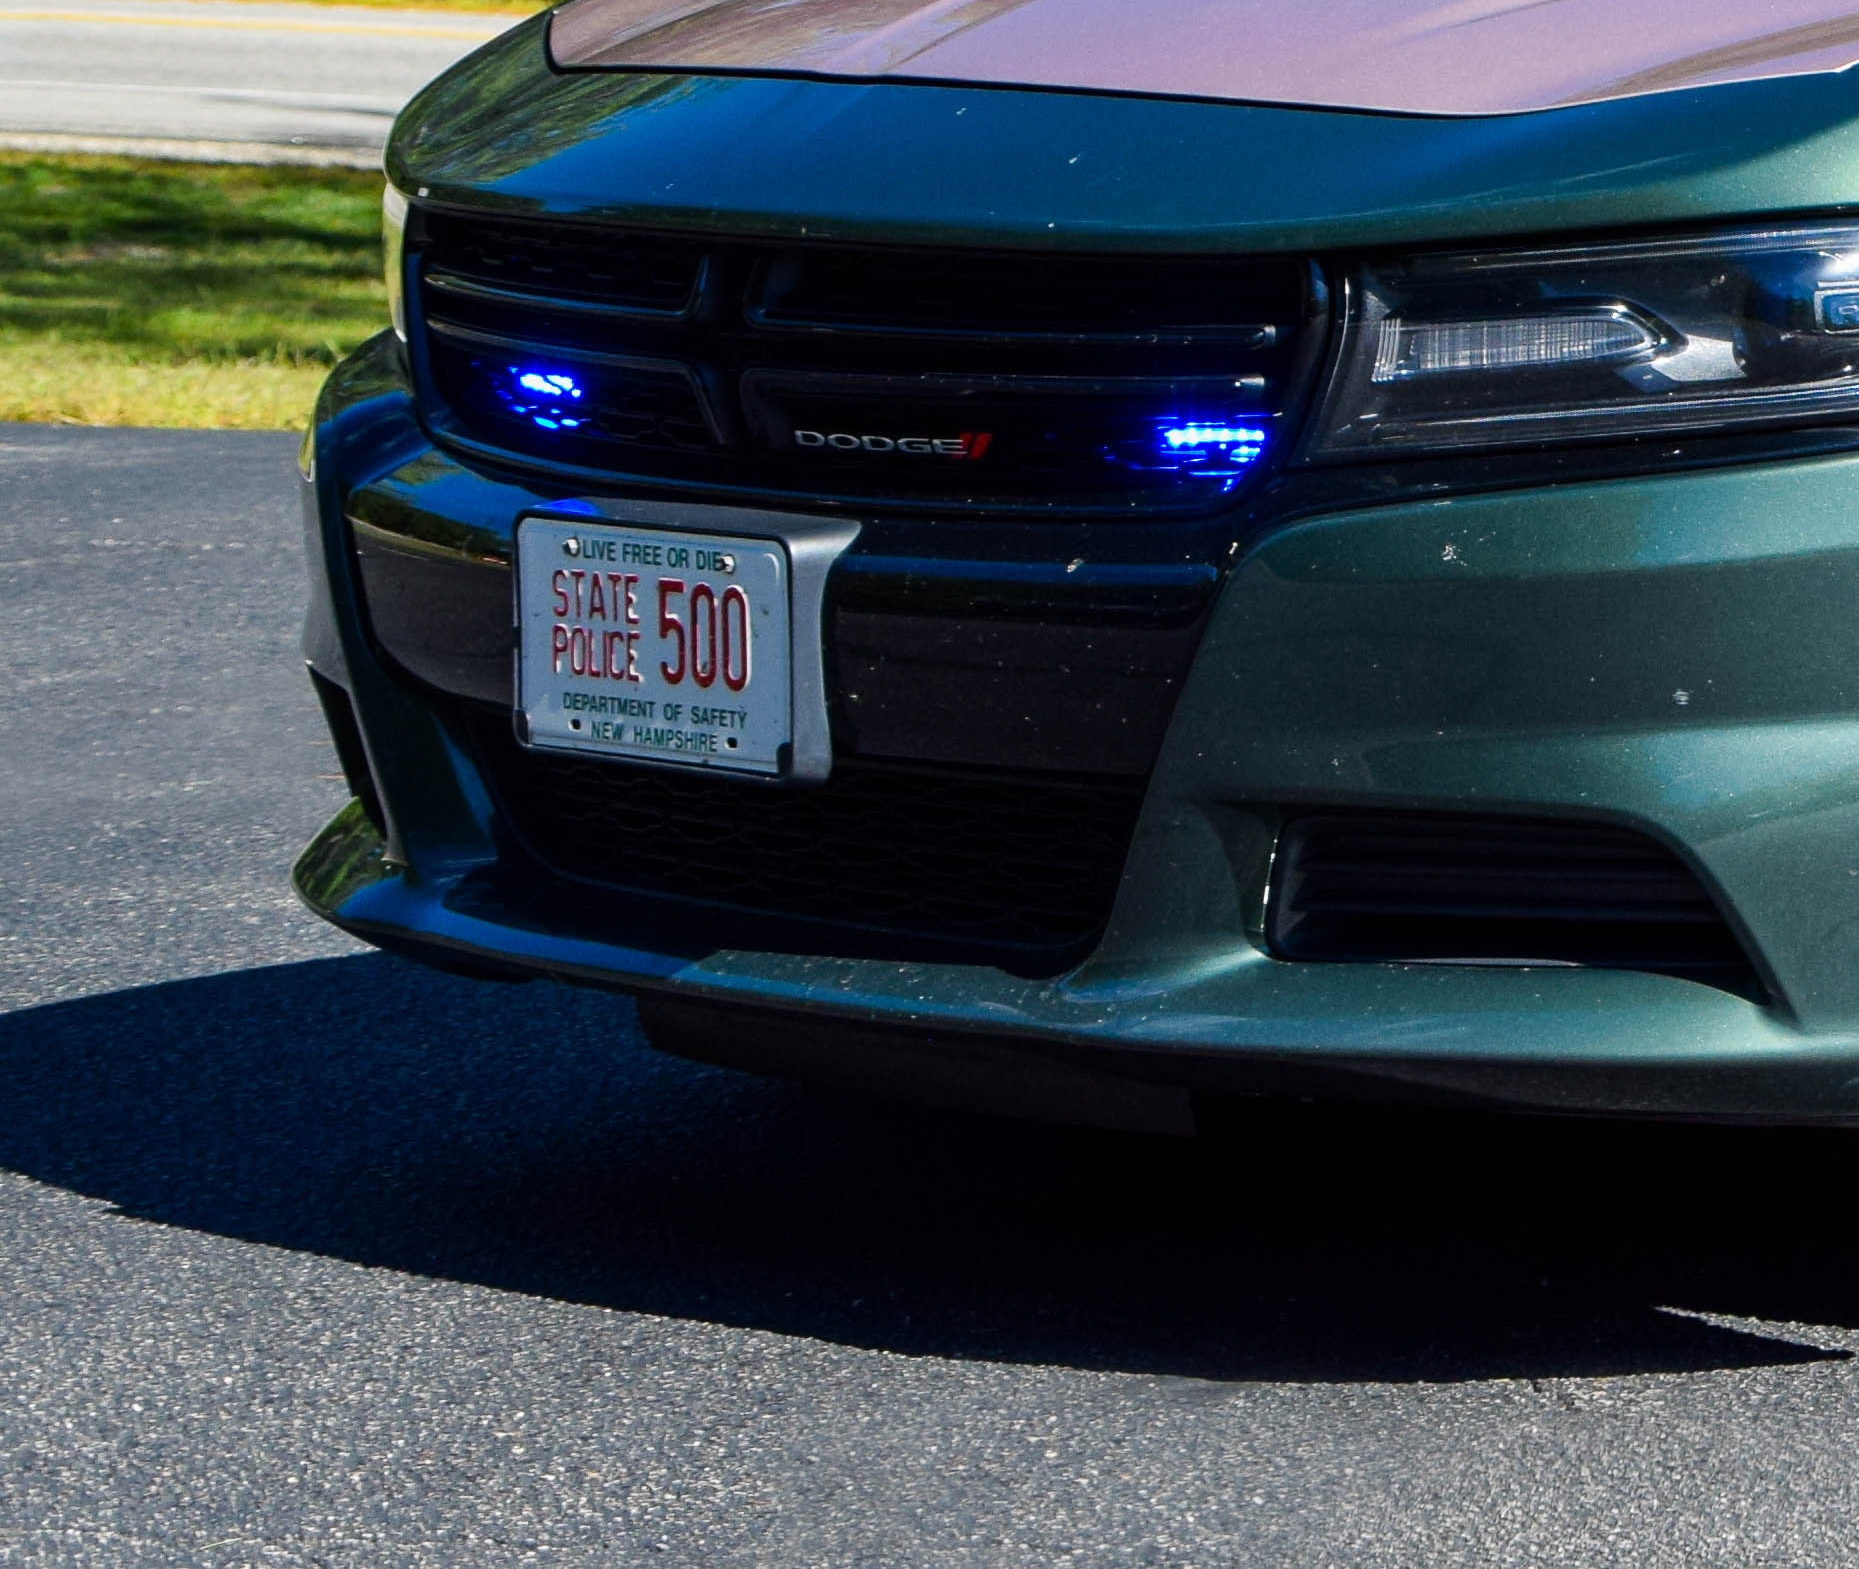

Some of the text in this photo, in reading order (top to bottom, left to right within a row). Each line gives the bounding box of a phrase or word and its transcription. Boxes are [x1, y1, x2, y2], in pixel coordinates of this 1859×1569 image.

[795, 430, 968, 455] DODGE
[583, 541, 724, 572] LIVE FREE OR DIE
[552, 569, 640, 625] STATE
[552, 623, 643, 683] POLICE
[657, 576, 751, 693] 500
[562, 692, 748, 729] DEPARTMENT OF SAFETY
[590, 721, 719, 752] NEW HAMPSHIRE
